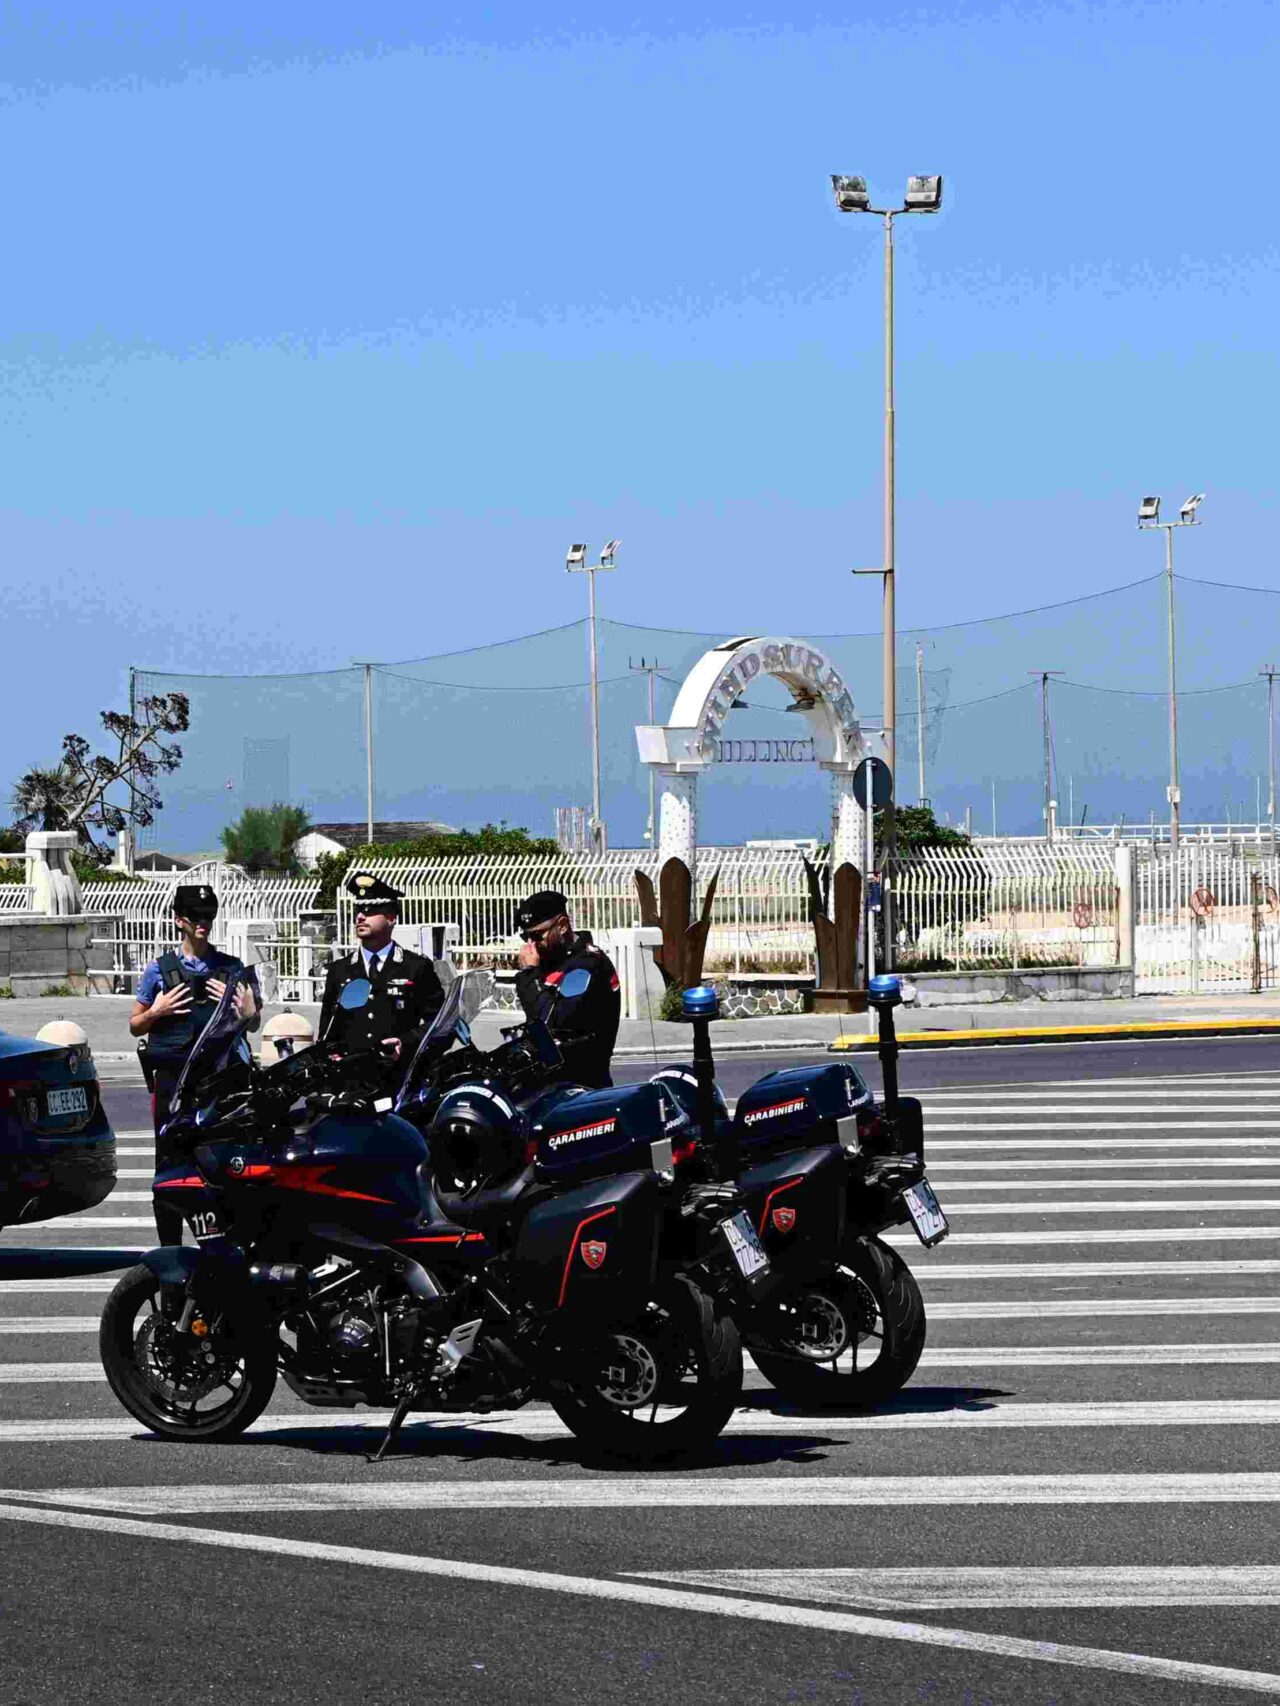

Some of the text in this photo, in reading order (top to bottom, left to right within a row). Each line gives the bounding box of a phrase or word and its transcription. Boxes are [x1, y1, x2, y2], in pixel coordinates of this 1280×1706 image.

[744, 1102, 804, 1123] CARABINIERI
[548, 1122, 615, 1147] CARABINIERI
[191, 1211, 218, 1235] 112
